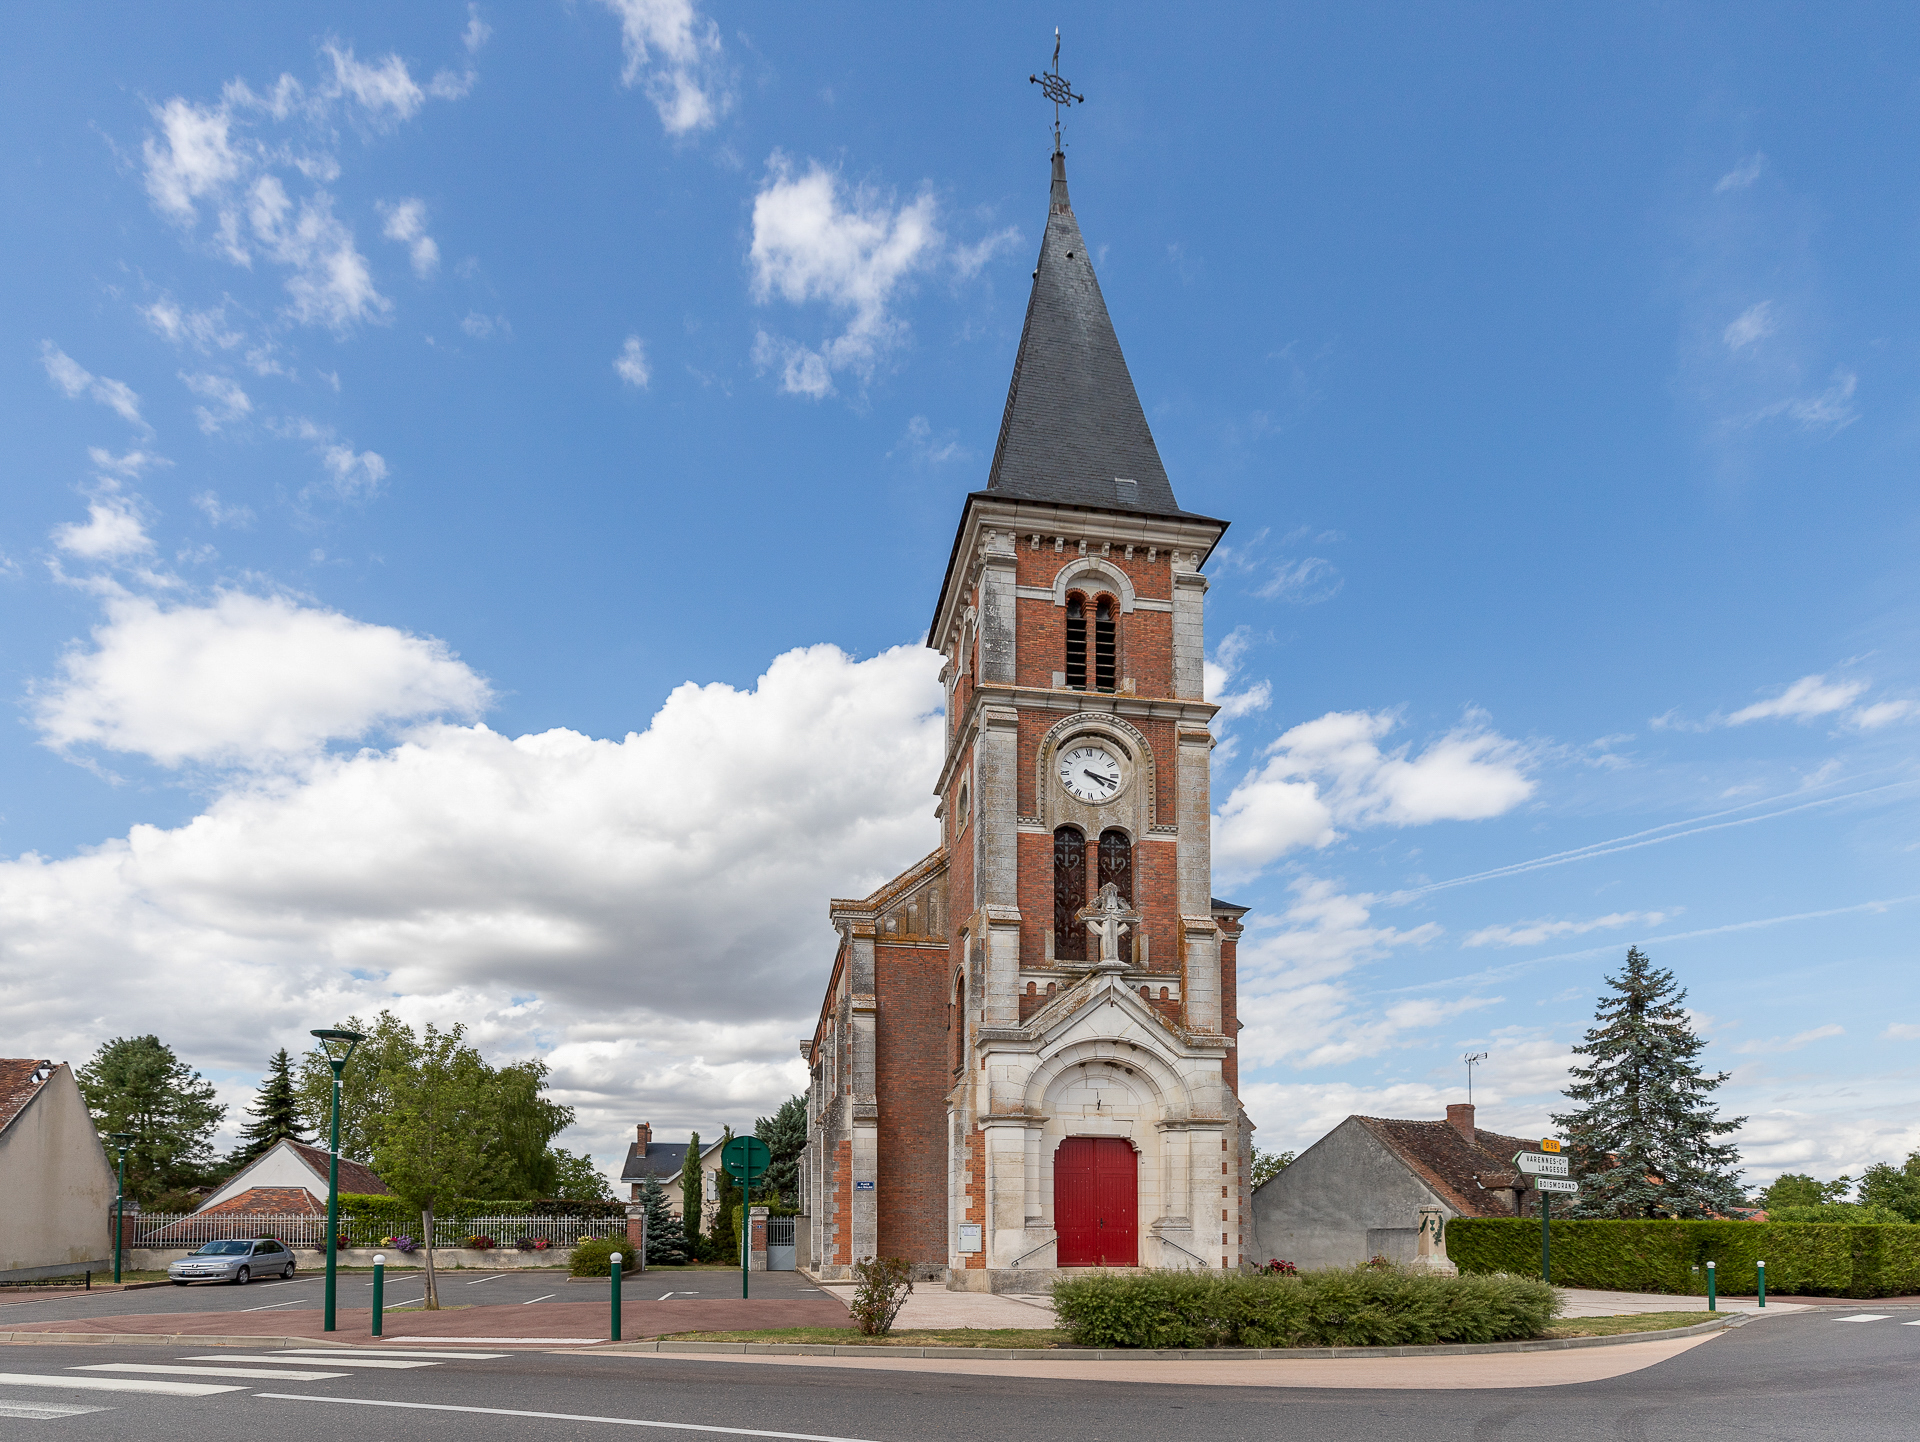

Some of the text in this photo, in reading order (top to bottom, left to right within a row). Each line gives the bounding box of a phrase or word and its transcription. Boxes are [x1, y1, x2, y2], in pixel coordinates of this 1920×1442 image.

[1550, 1142, 1558, 1150] 56
[1538, 1164, 1567, 1174] LANGESSE
[1539, 1180, 1576, 1190] BOISMORAND
